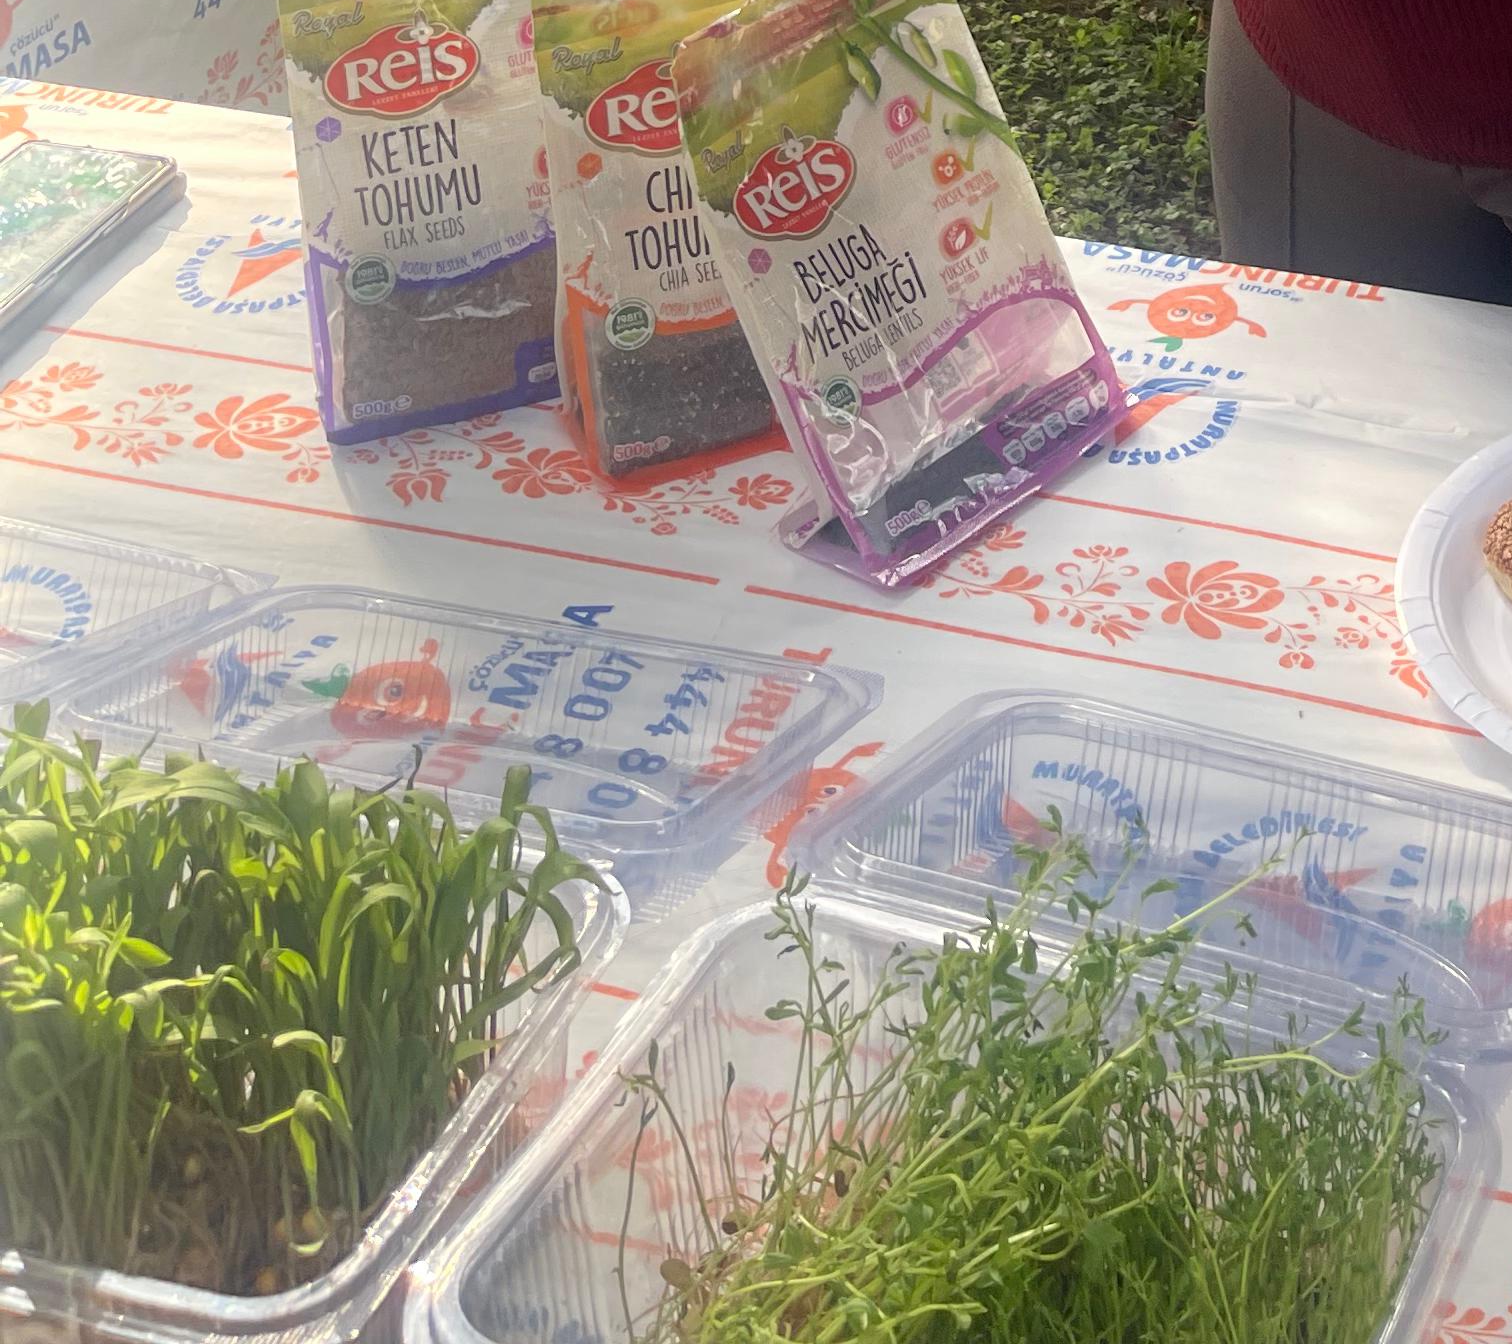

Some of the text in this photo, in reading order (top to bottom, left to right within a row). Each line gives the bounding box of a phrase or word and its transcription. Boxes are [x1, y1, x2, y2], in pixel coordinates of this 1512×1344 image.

[291, 0, 366, 39] Royal
[343, 40, 469, 102] Reis
[552, 36, 624, 76] Royal
[604, 86, 678, 138] Re
[361, 118, 460, 180] KETEN
[354, 163, 482, 226] TOHUMU
[646, 164, 694, 214] CHI
[743, 147, 847, 230] Reis
[383, 215, 466, 251] FLAX SEEDS
[624, 214, 711, 272] TOHU
[659, 259, 723, 292] CHIA SEE
[793, 224, 887, 305] BELUGA
[801, 251, 928, 365] MERCİMEĞİ
[841, 332, 885, 372] BELUGA
[353, 398, 393, 419] 500g
[613, 441, 653, 462] 500g
